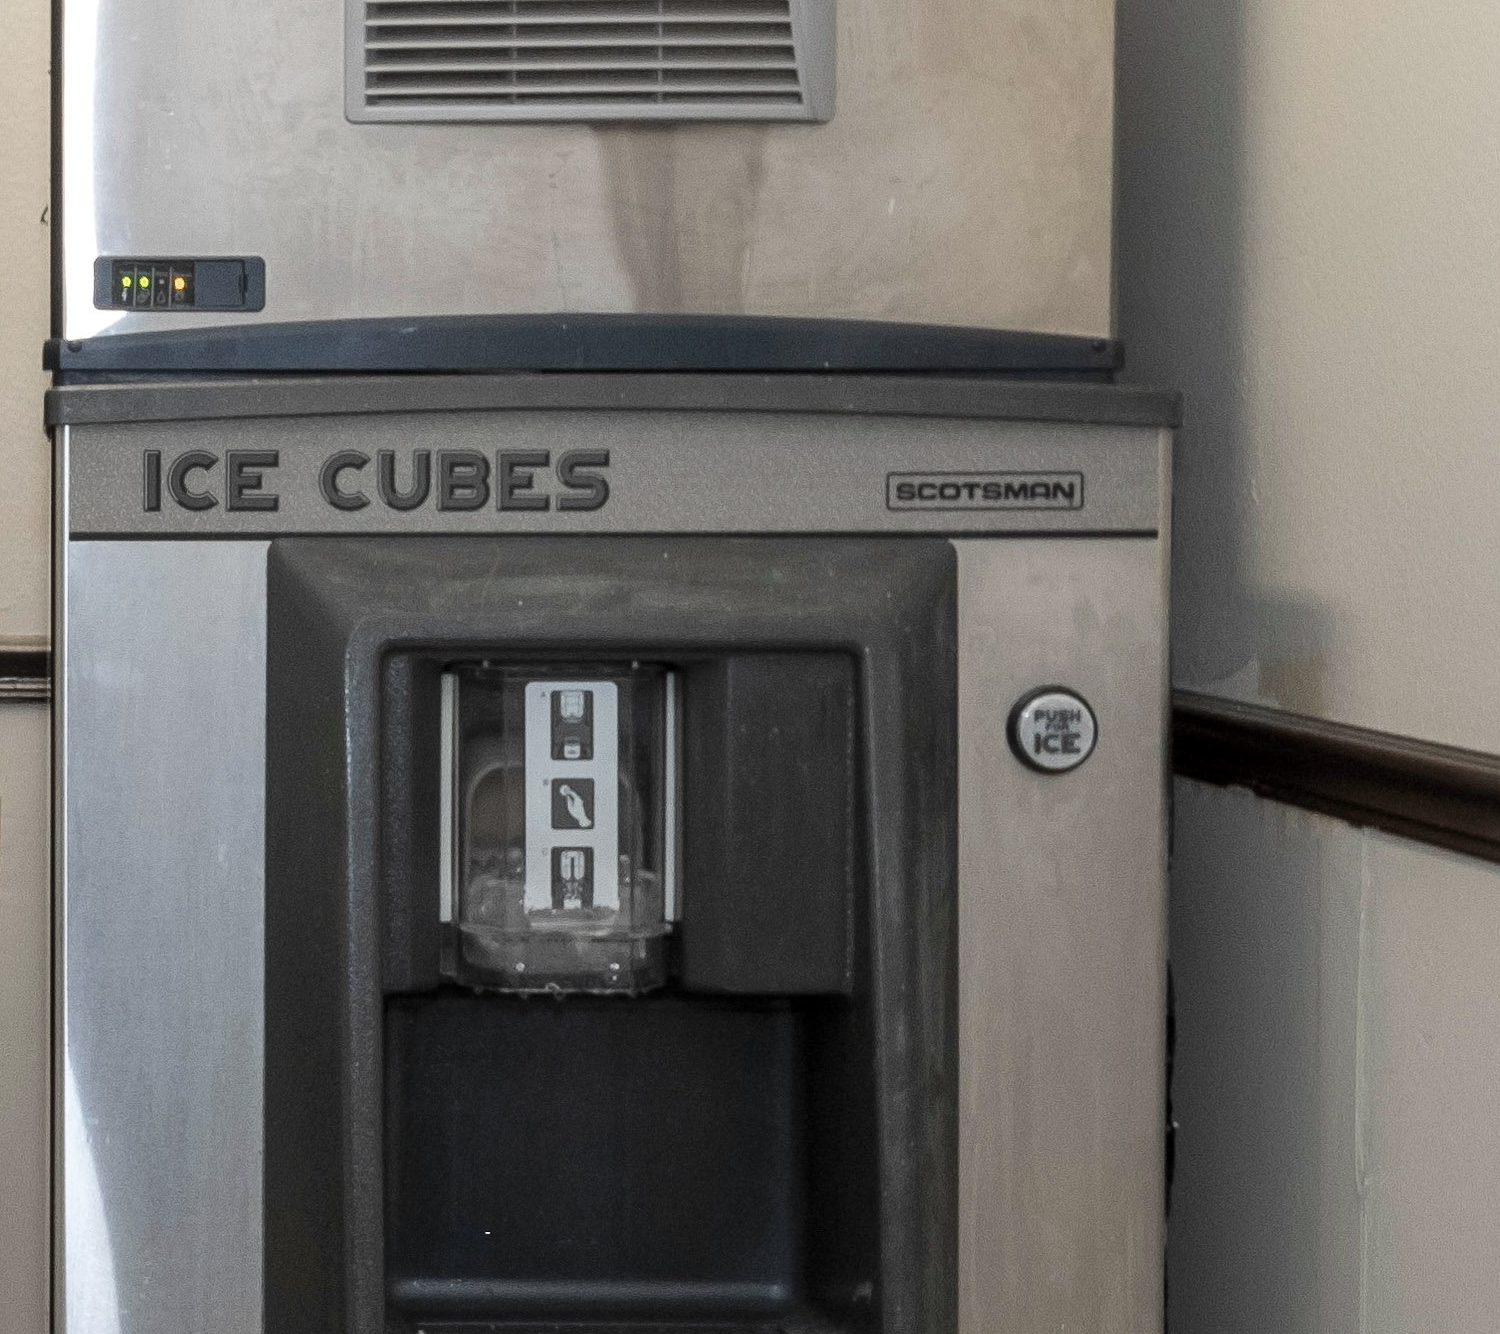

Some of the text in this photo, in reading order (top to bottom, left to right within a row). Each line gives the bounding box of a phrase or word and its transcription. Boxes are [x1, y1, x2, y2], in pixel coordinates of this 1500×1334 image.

[143, 449, 611, 513] ICE CUBES
[895, 480, 1076, 502] SCOTSMAN
[1034, 733, 1081, 755] ICE
